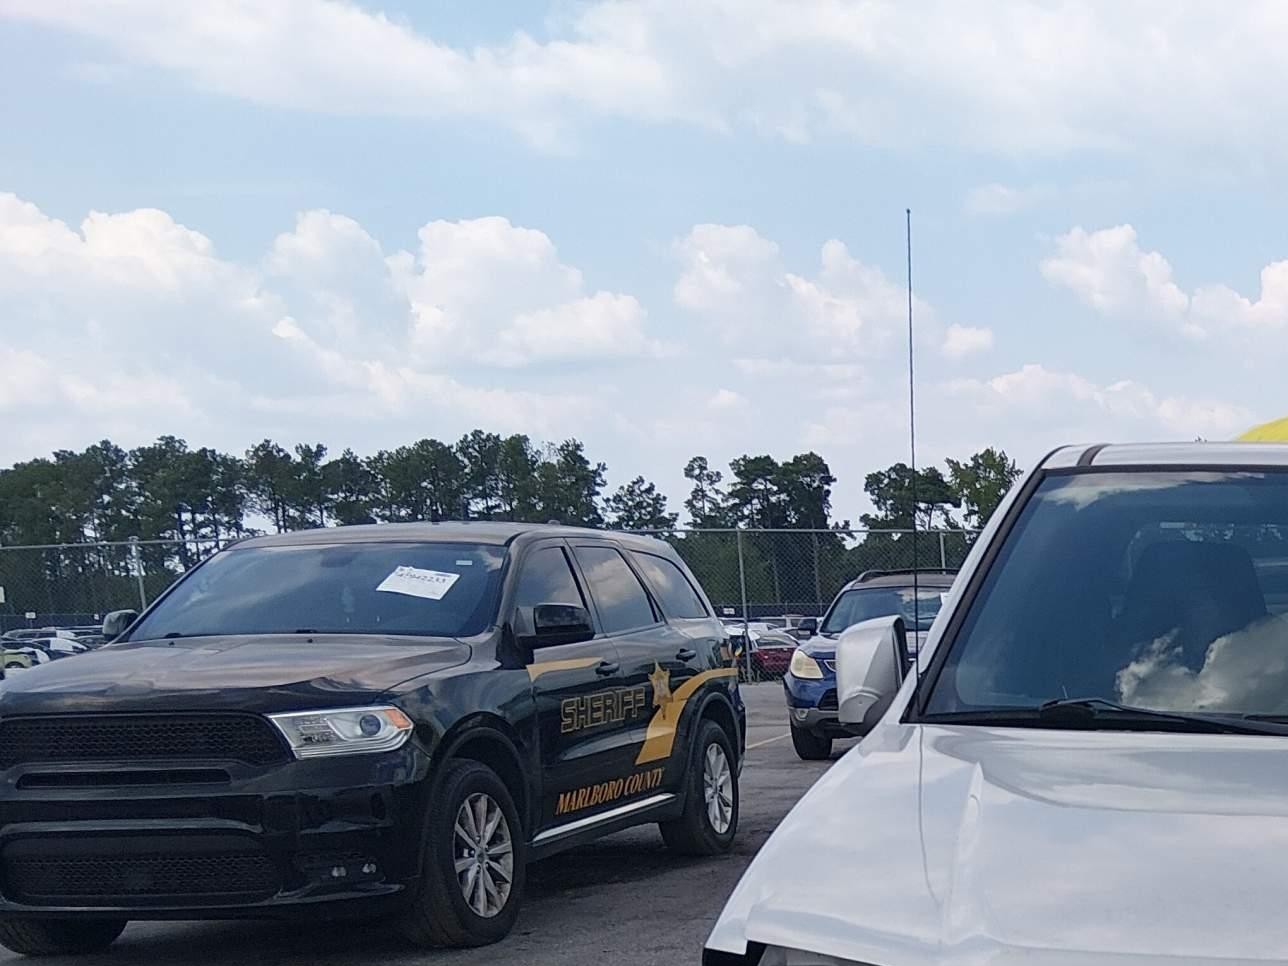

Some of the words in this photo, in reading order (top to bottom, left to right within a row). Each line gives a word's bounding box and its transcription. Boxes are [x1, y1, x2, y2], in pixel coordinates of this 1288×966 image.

[561, 688, 645, 733] SHERIFF
[557, 780, 624, 814] MARLBORO
[625, 769, 664, 794] COUNTY
